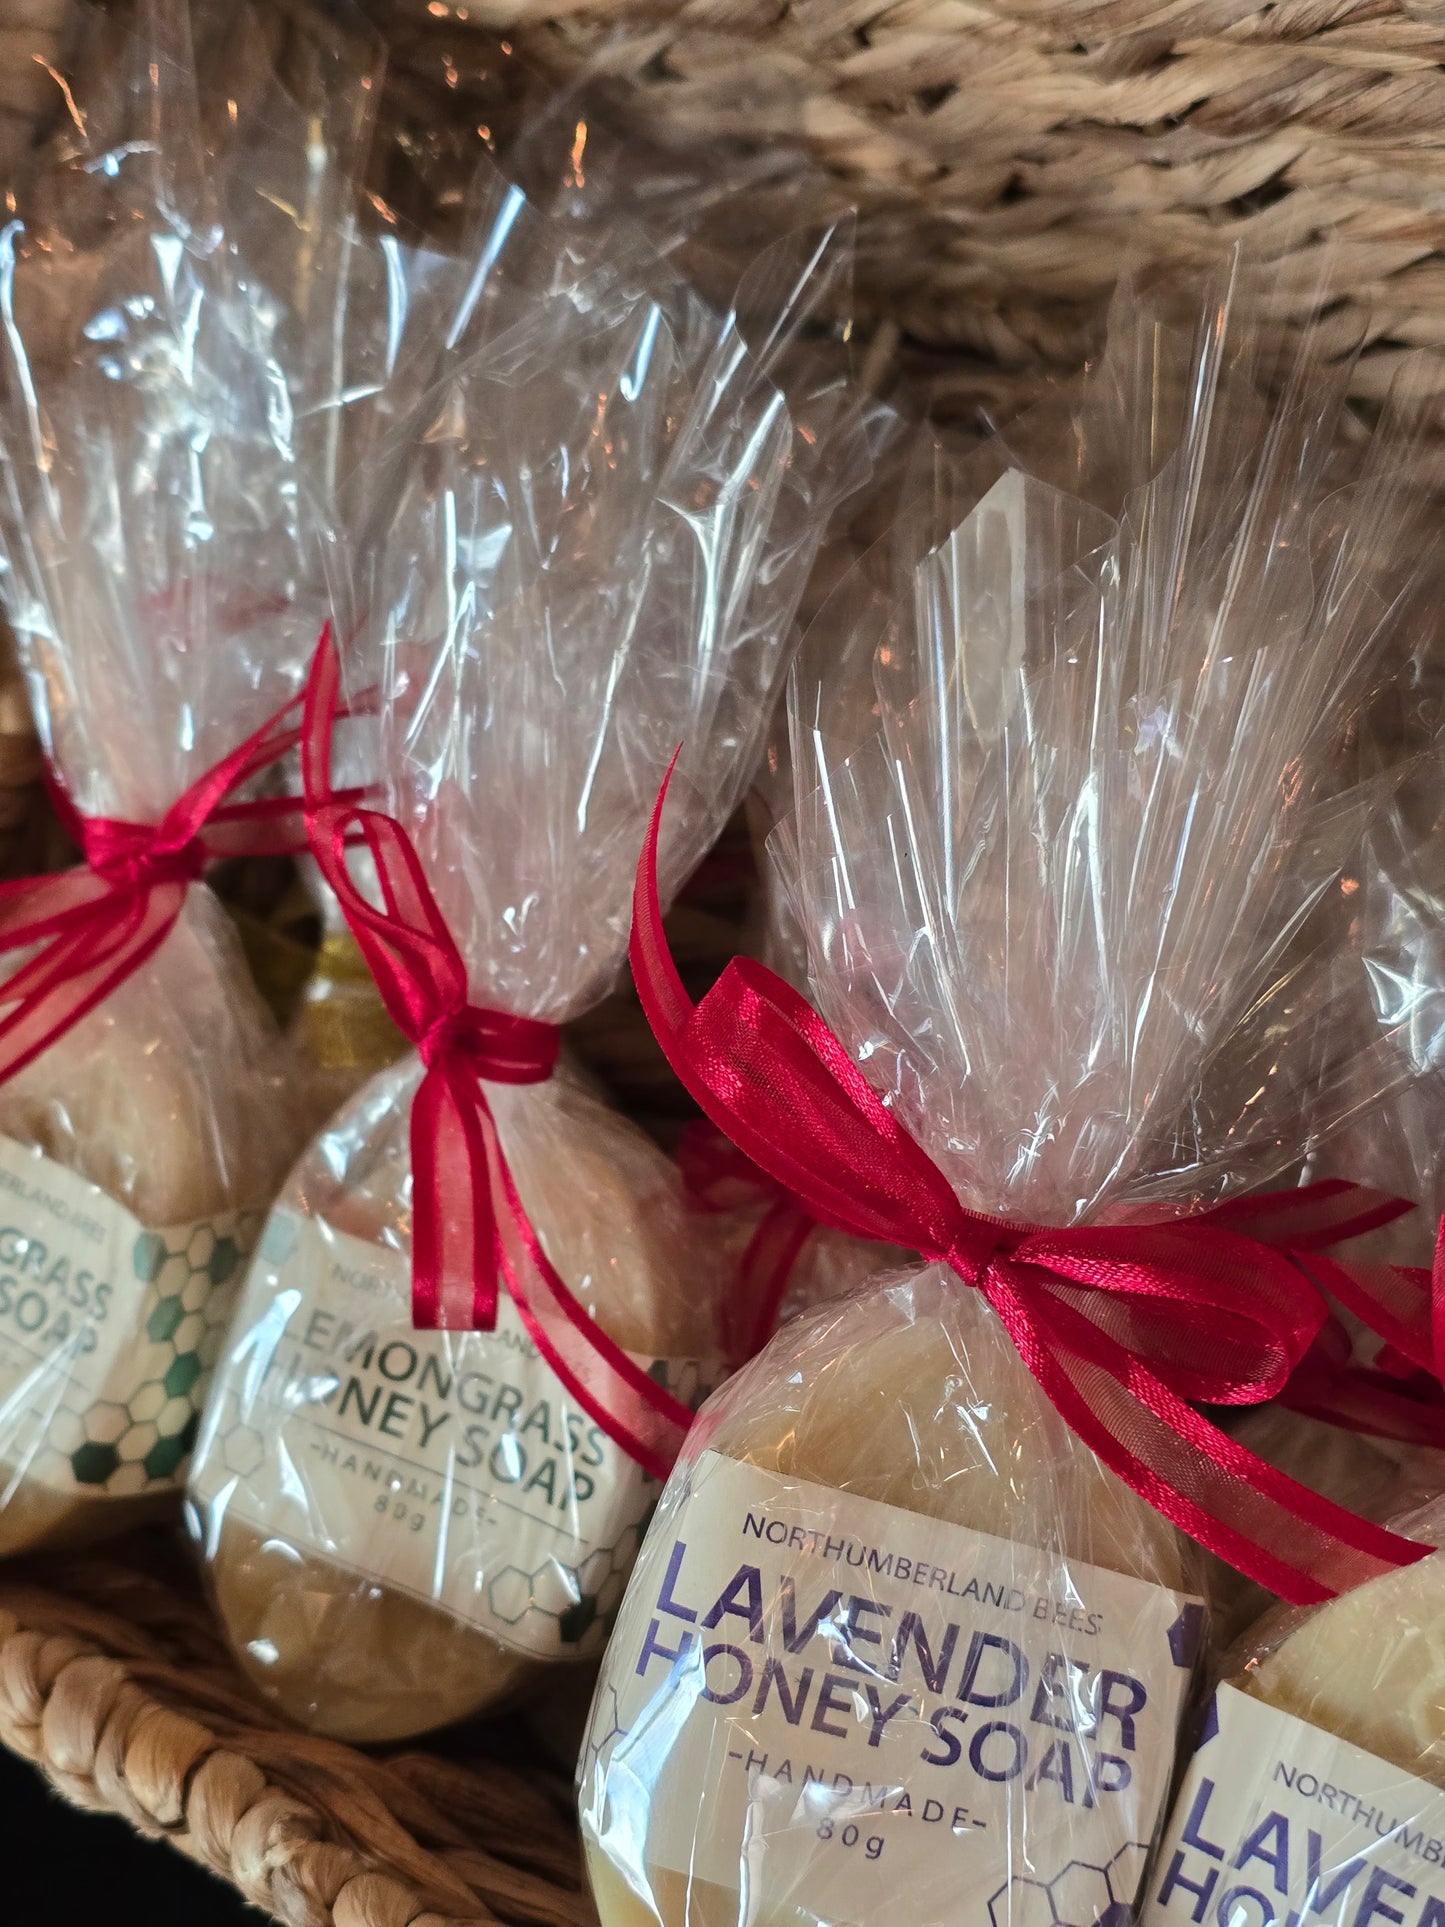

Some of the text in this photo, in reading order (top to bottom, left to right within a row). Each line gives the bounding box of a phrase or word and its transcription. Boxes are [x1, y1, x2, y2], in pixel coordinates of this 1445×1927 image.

[270, 1300, 605, 1467] EMONGRASS
[374, 1494, 426, 1532] 80g
[456, 1424, 595, 1511] SOAP
[742, 1512, 1104, 1636] NORTHUMBERLAND BEES
[656, 1541, 1147, 1751] LAVENDER
[635, 1618, 1132, 1808] HONEY SOAP
[816, 1817, 885, 1860] 80g
[1181, 1777, 1445, 1927] LAVE
[1272, 1760, 1445, 1870] NORTHUMB
[1157, 1848, 1300, 1927] HO
